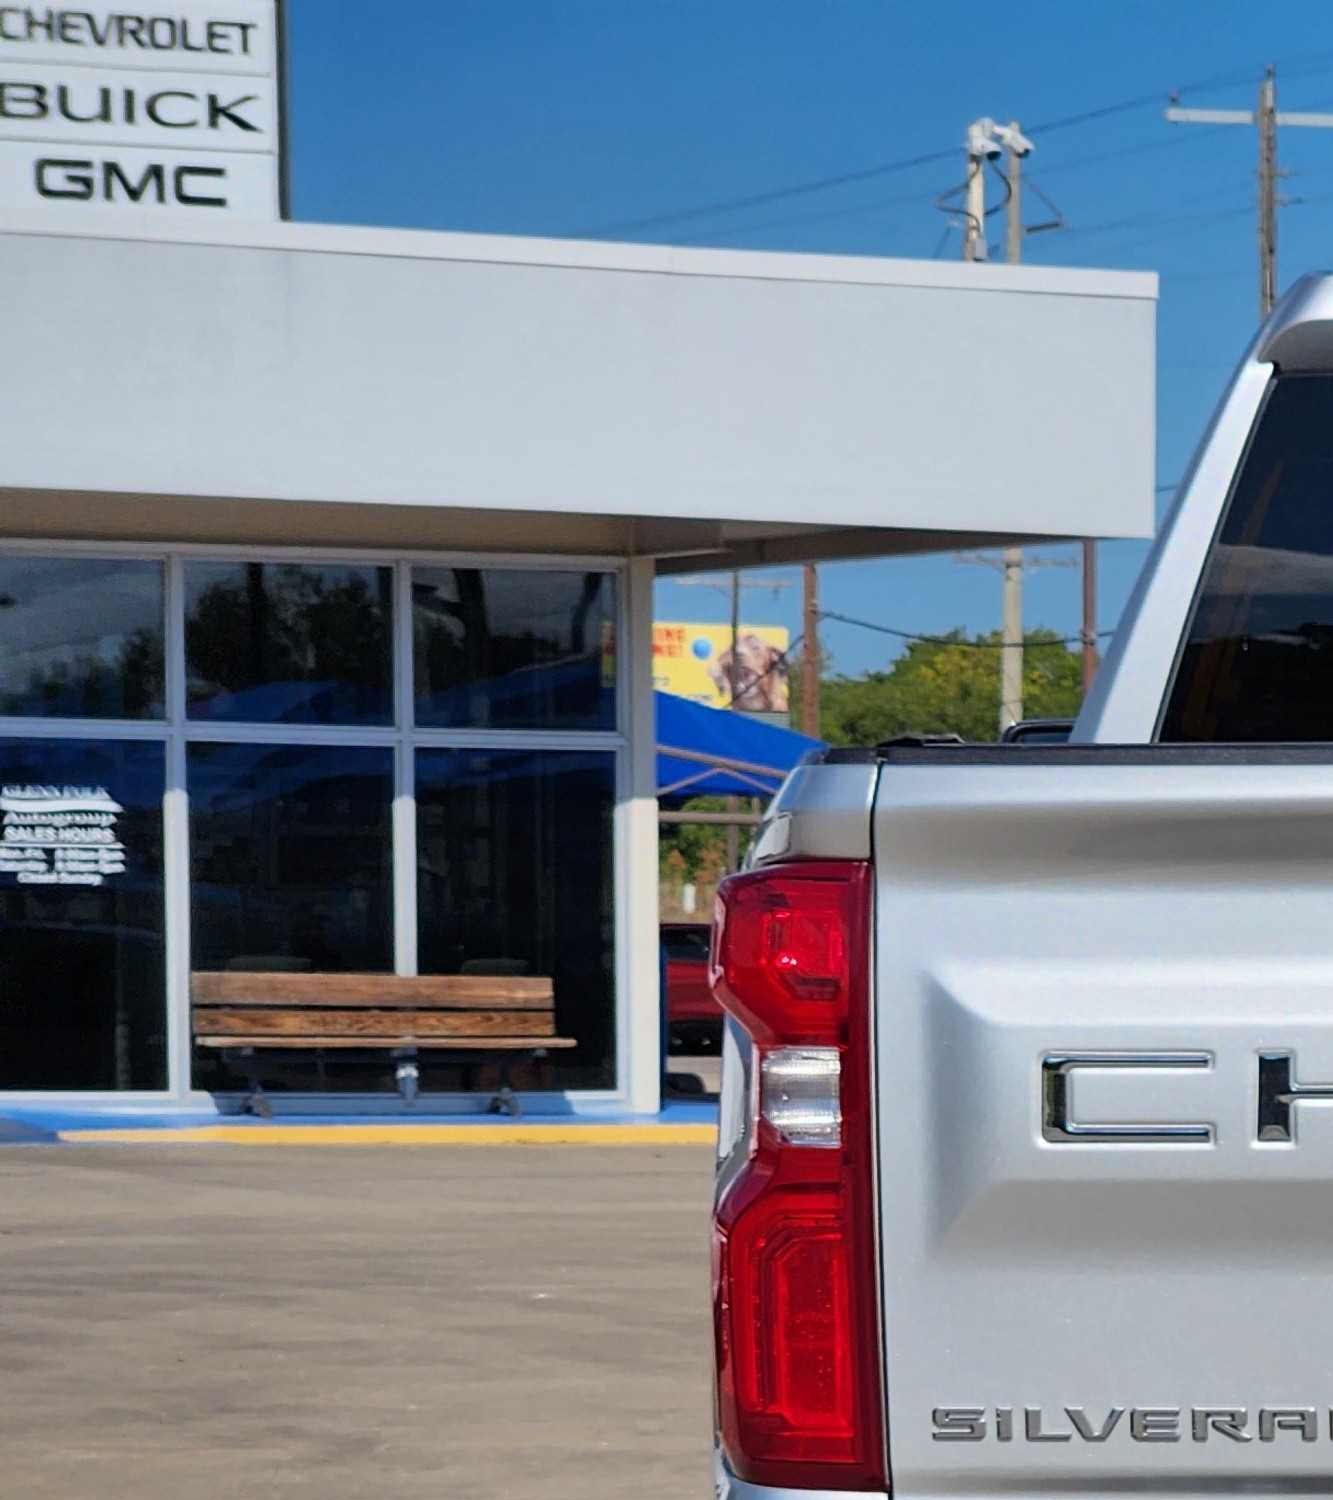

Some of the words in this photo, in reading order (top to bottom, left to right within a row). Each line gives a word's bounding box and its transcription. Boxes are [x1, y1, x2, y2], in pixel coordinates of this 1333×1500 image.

[0, 7, 258, 54] CHEVROLET
[0, 81, 264, 134] BUICK
[34, 157, 228, 208] GMC
[4, 826, 57, 842] SALES
[58, 827, 116, 843] HOURS
